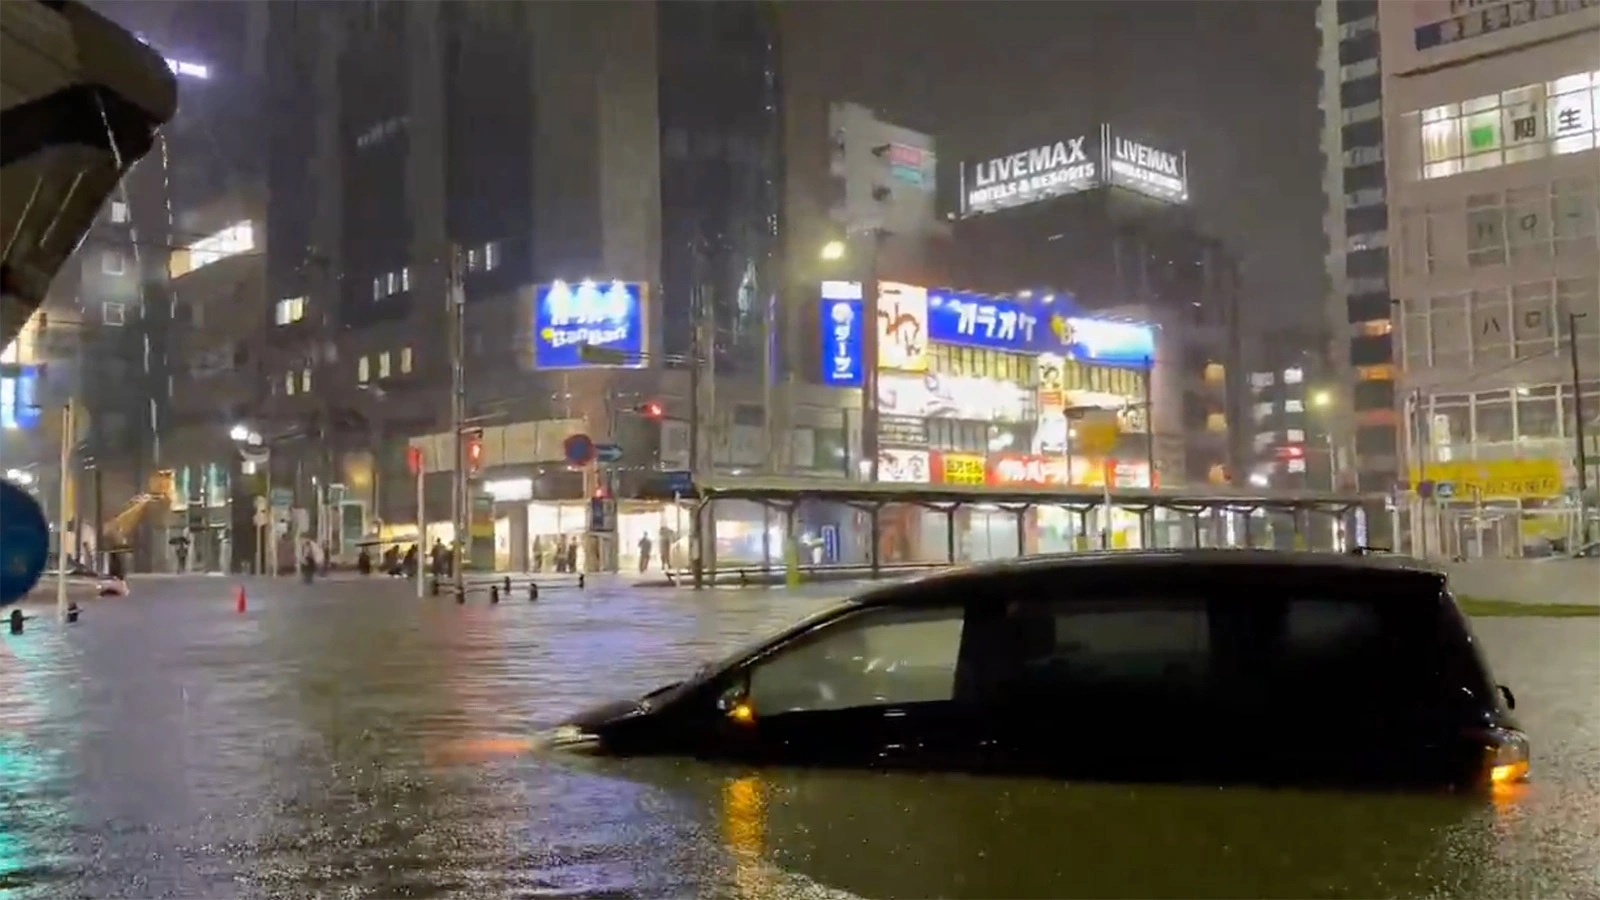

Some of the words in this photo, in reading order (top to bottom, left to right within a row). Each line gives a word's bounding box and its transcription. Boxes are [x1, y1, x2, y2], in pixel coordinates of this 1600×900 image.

[976, 135, 1087, 188] LIVEMAX
[1115, 136, 1179, 177] LIVEMAX
[968, 181, 1018, 206] HOTELS
[1031, 162, 1096, 190] RESORTS
[954, 300, 1037, 342] カラオケ
